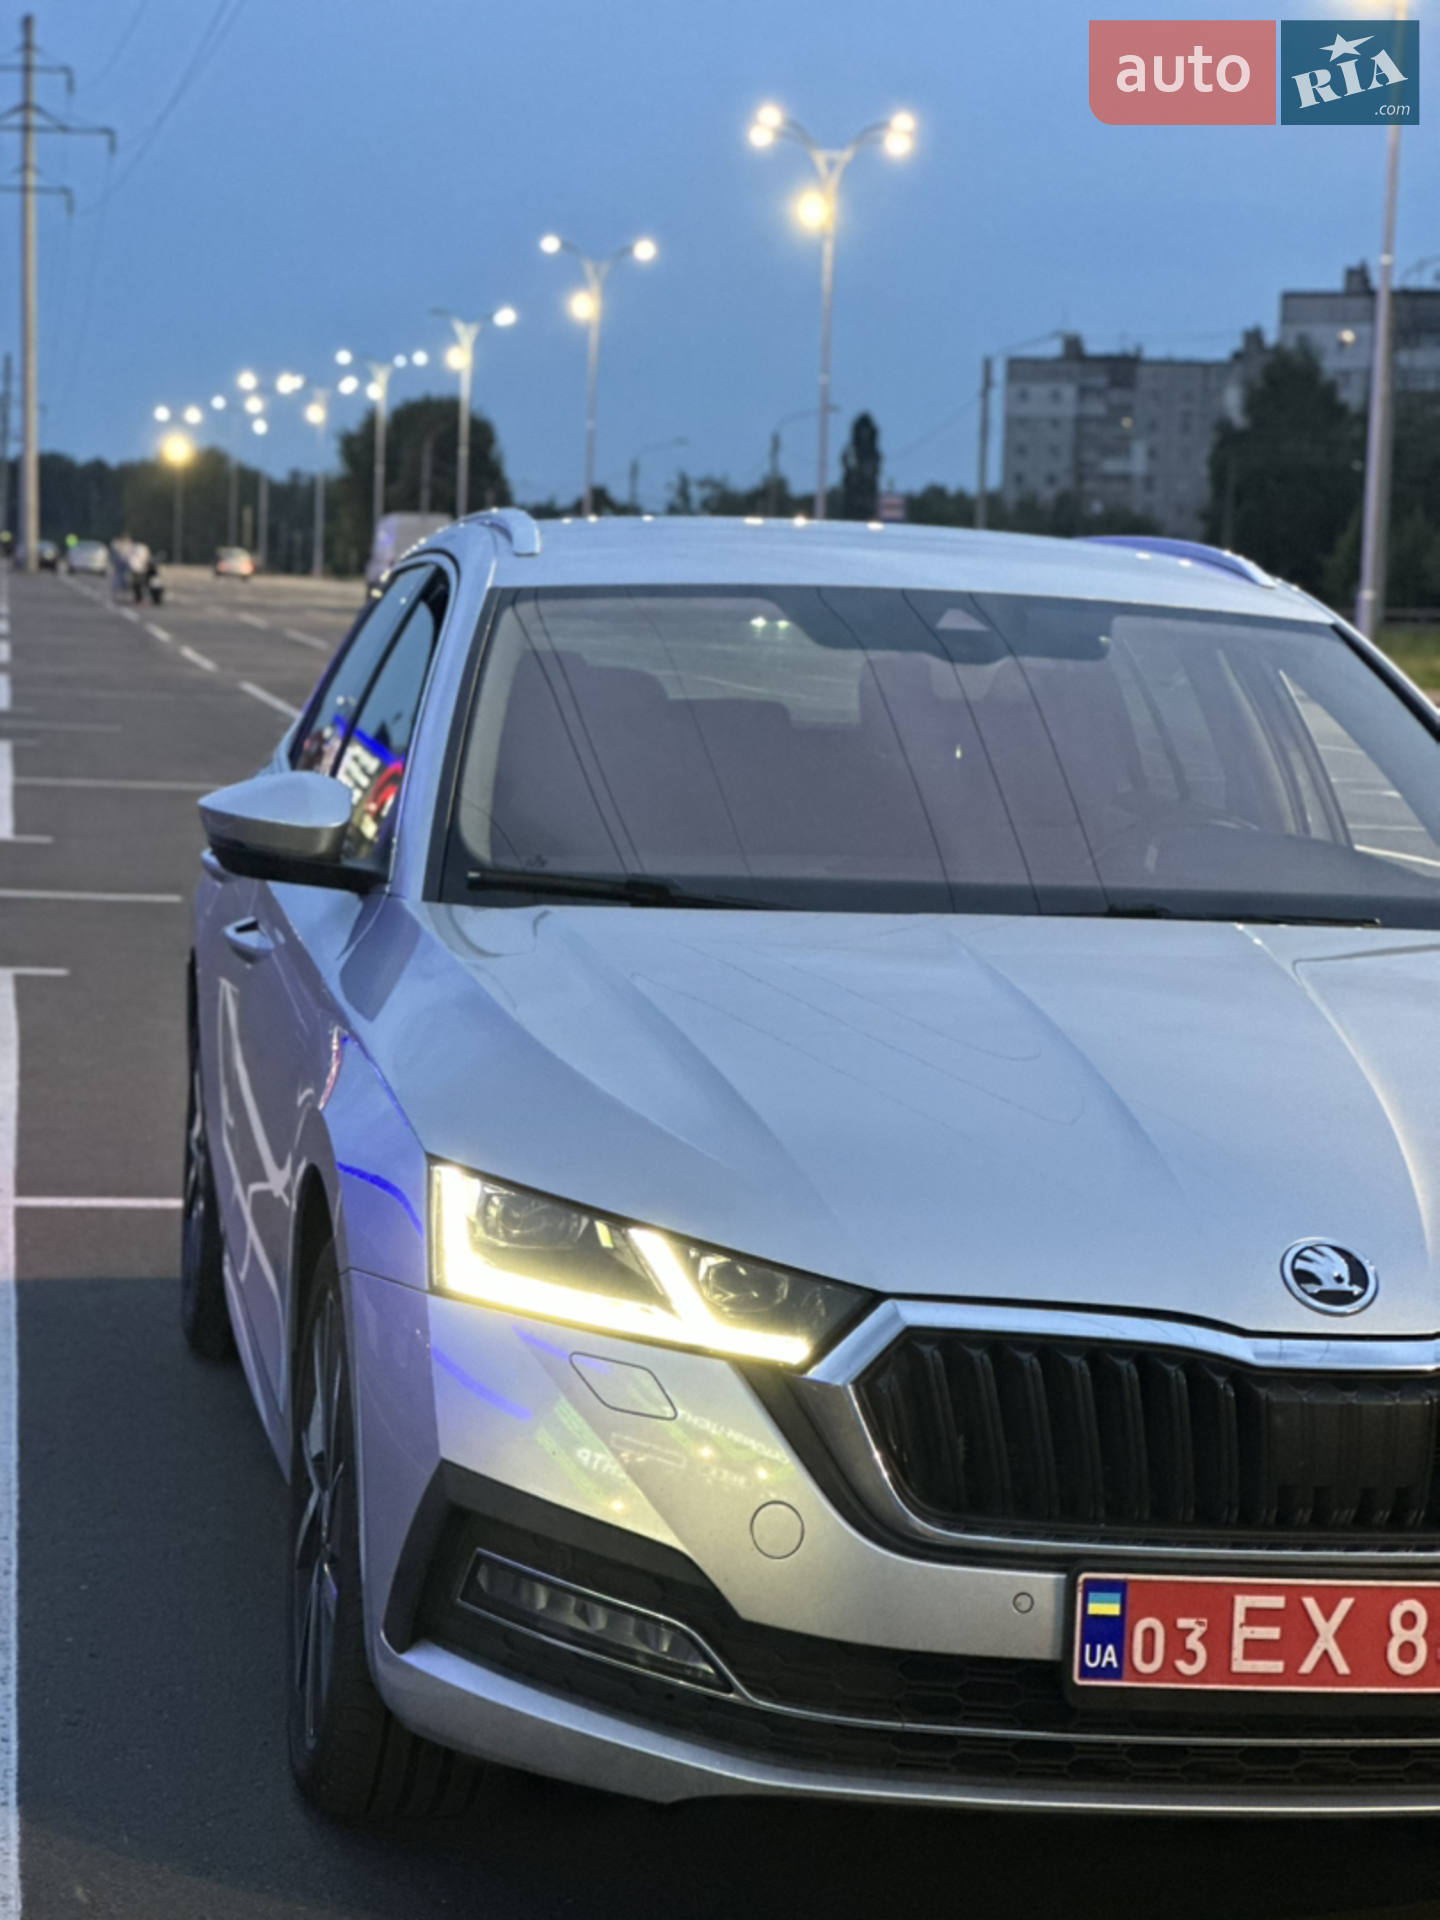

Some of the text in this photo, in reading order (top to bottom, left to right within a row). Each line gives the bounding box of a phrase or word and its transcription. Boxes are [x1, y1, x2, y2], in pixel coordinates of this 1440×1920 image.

[1084, 1643, 1119, 1669] UA
[1132, 1594, 1440, 1676] 03 EX 8
